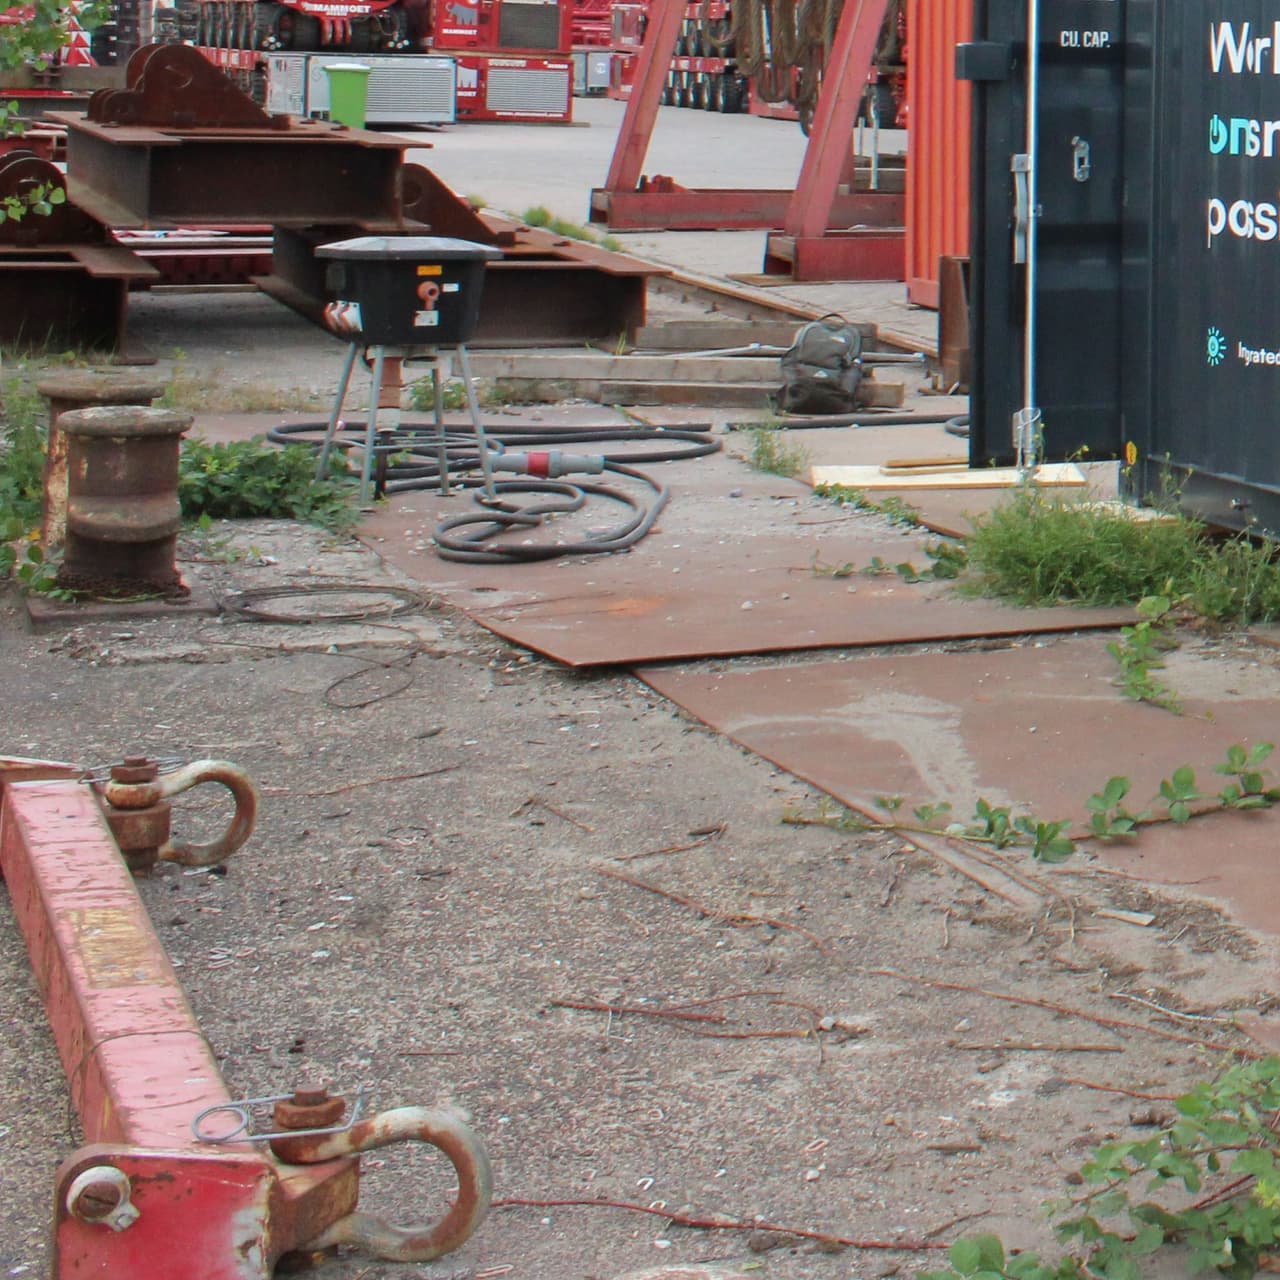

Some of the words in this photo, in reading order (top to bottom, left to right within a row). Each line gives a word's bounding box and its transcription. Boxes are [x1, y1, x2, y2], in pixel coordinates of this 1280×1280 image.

[315, 4, 371, 14] MAMMOET
[1060, 31, 1081, 48] CU.
[1083, 32, 1111, 49] CAP.
